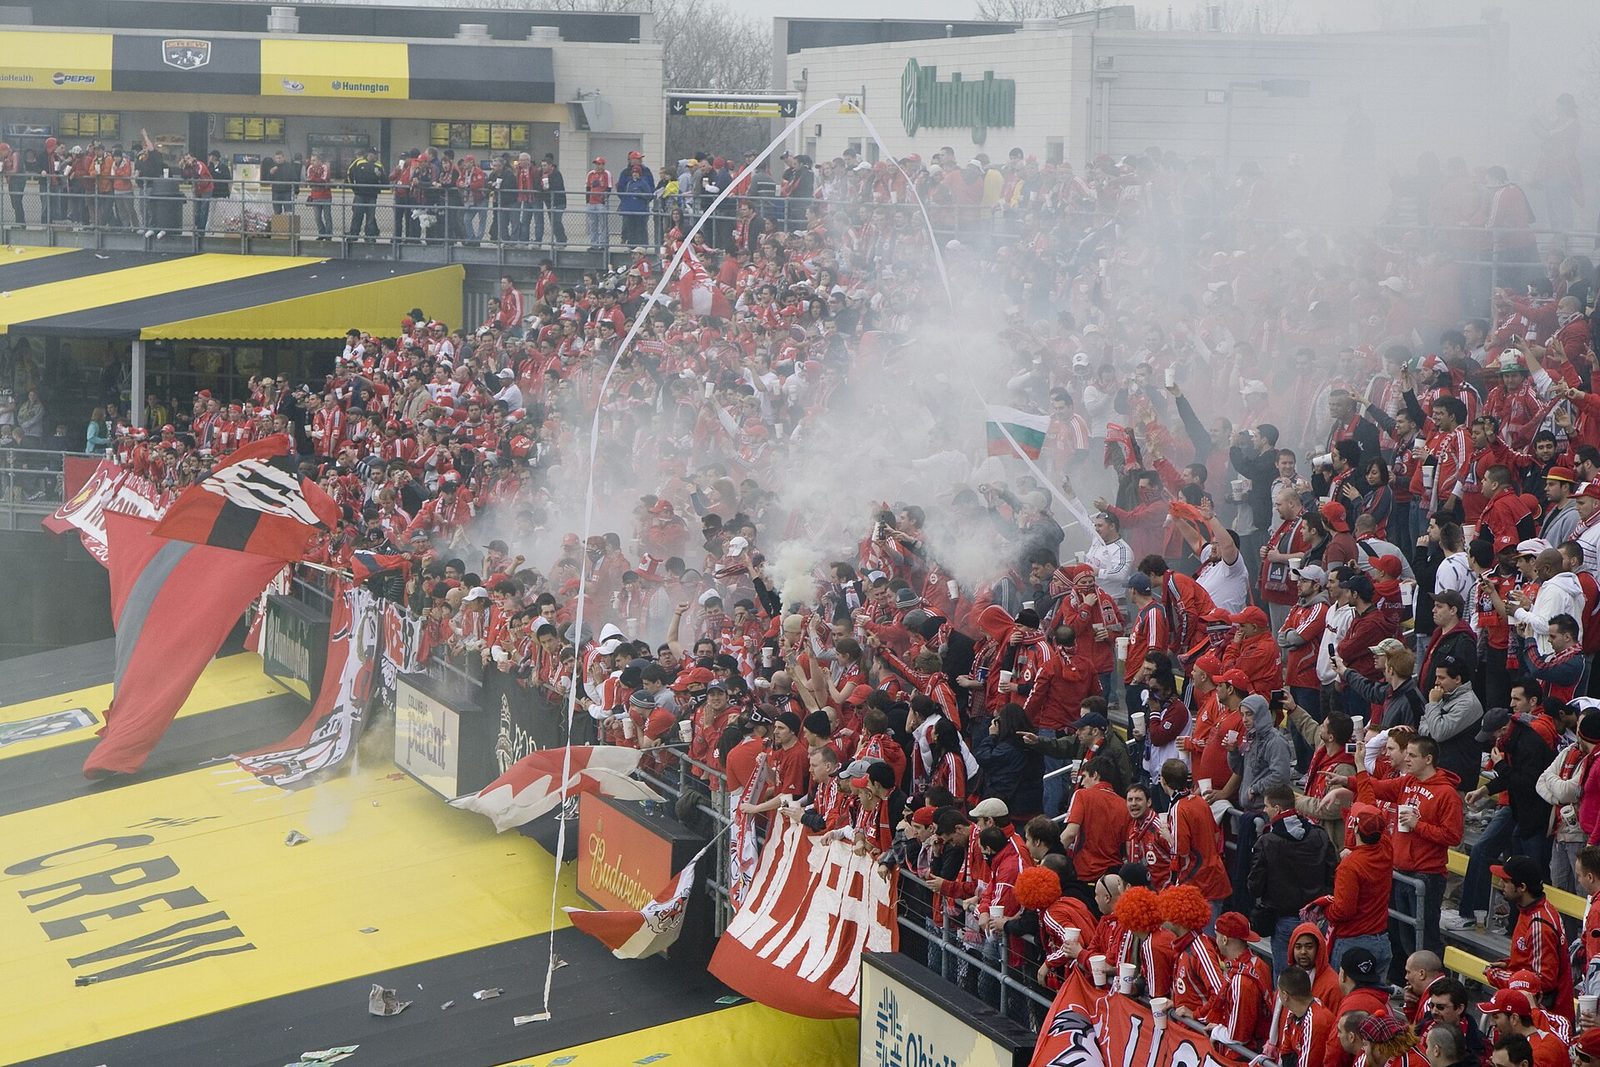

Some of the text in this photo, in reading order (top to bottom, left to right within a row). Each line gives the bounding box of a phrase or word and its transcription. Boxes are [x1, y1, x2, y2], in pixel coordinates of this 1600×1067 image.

[0, 74, 33, 82] ioHealth
[64, 75, 96, 83] PEPSI
[342, 82, 390, 93] Huntington
[708, 101, 760, 110] EXIT RAMP
[406, 710, 447, 770] parent
[4, 834, 258, 987] CREW
